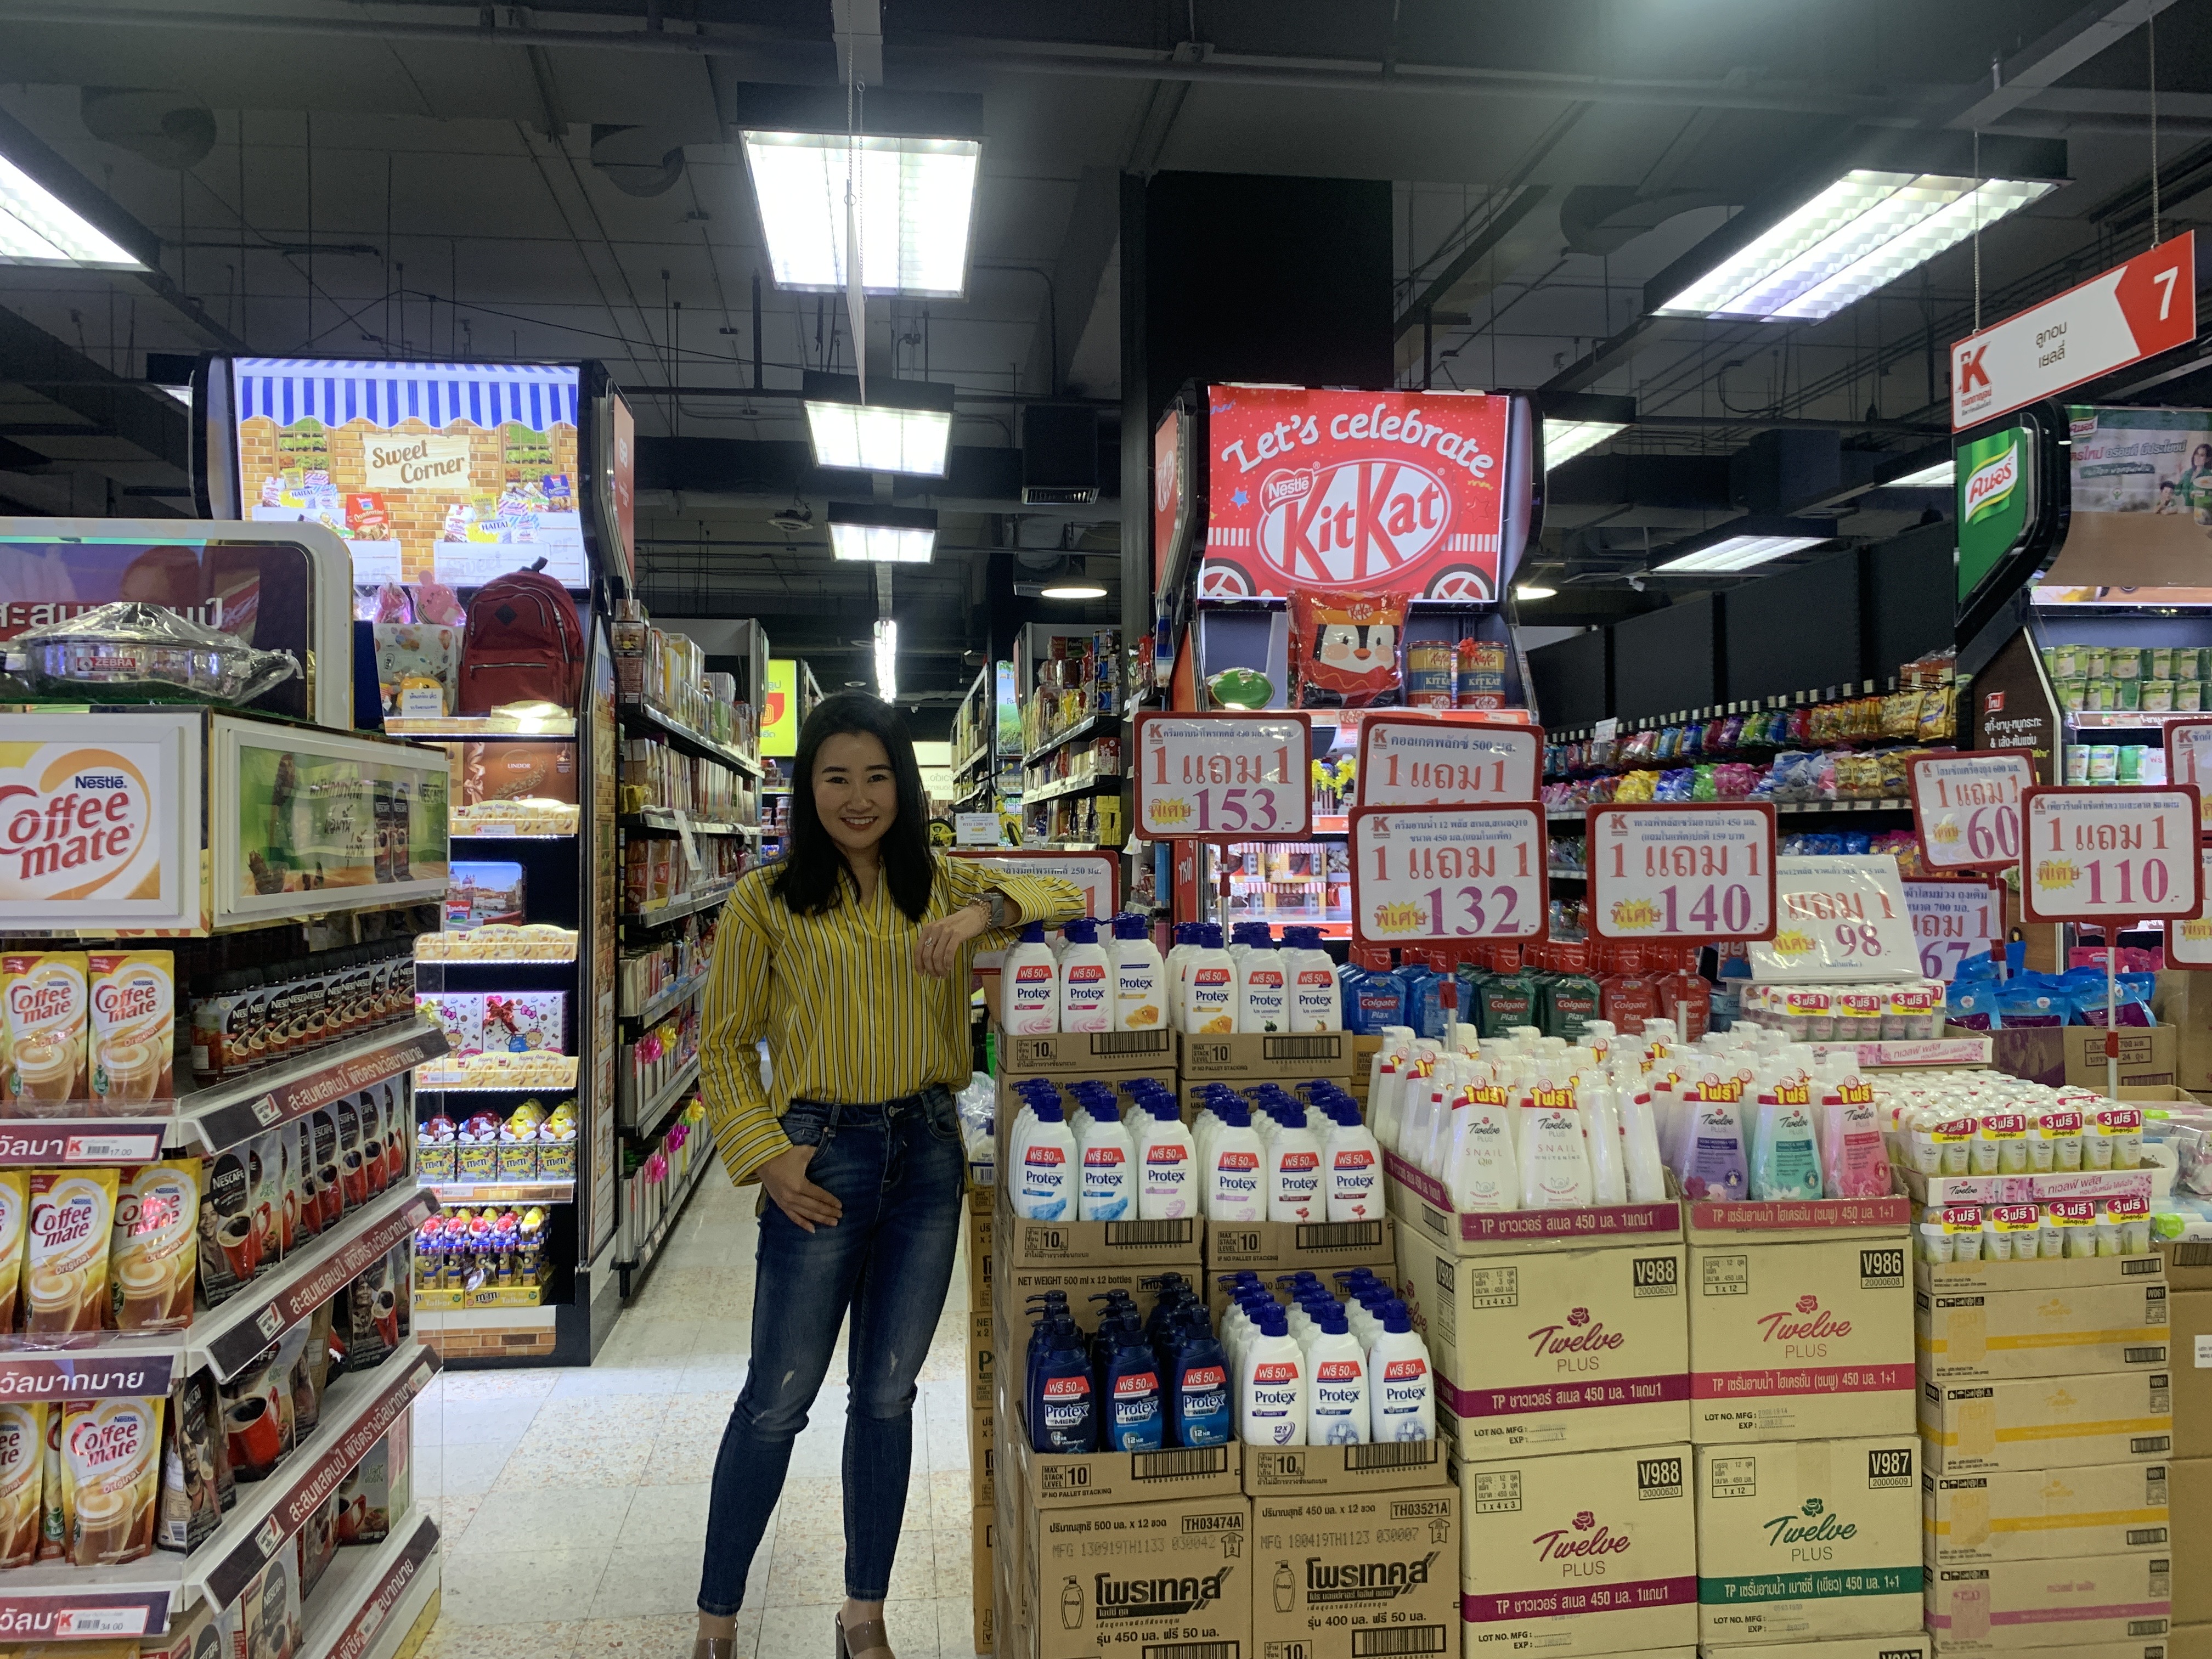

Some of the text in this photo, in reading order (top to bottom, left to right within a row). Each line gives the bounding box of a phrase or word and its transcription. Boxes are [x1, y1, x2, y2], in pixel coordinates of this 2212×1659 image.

[2154, 267, 2178, 321] 7
[2036, 321, 2067, 348] ลูกอม
[2039, 340, 2065, 368] เยลลี่
[1330, 404, 1494, 478] celebrate
[372, 438, 428, 469] Sweet
[400, 454, 466, 484] Corner
[1268, 475, 1310, 500] Nestlé
[481, 521, 509, 531] HAITAI
[1283, 464, 1440, 581] KitKat
[1348, 604, 1372, 620] KitKat
[95, 658, 133, 667] ZEBRA
[1472, 740, 1492, 751] 500
[1152, 746, 1293, 784] 1 แถม 1
[1384, 754, 1506, 793] 1 แถม 1
[75, 775, 125, 789] Nestlé
[1956, 782, 2003, 806] แถม
[1149, 799, 1191, 817] พิเศษ
[1968, 805, 2019, 860] 60
[19, 825, 131, 879] mate
[1610, 842, 1761, 877] 1 แถม 1
[1373, 842, 1532, 881] 1 แถม 1
[2036, 861, 2080, 880] พิเศษ
[1374, 905, 1427, 926] พิเศษ
[1611, 901, 1662, 922] พิเศษ
[1934, 904, 1970, 913] 700 มล.
[1021, 968, 1043, 978] ฟรี 50
[1074, 968, 1096, 978] ฟรี 50
[1120, 978, 1153, 989] Protex
[11, 985, 71, 1014] Coffee
[95, 985, 156, 1012] Coffee
[1018, 988, 1051, 1000] Protex
[1070, 988, 1105, 1000] Protex
[1196, 990, 1229, 1003] Protex
[1250, 995, 1283, 1007] Protex
[1299, 995, 1332, 1006] Protex
[1362, 998, 1397, 1008] Colgate
[1491, 1000, 1526, 1009] Colgate
[22, 1001, 71, 1024] mate
[109, 1000, 156, 1023] mate
[1371, 1011, 1389, 1019] Plax
[1500, 1012, 1518, 1020] Plax
[125, 1026, 157, 1047] Original
[1034, 1042, 1048, 1057] 10
[1212, 1046, 1228, 1060] 10
[1701, 1114, 1734, 1125] Twelve
[1780, 1116, 1808, 1128] Twelve
[1844, 1109, 1874, 1121] Twelve
[1468, 1123, 1500, 1134] Twelve
[1538, 1118, 1572, 1129] Twelve
[1466, 1148, 1502, 1156] SNAIL
[1026, 1171, 1063, 1186] Protex
[1086, 1172, 1123, 1186] Protex
[1481, 1219, 1494, 1233] TP
[1547, 1218, 1571, 1231] สเนล
[1576, 1216, 1595, 1229] 450
[55, 1251, 91, 1274] Original
[1864, 1252, 1901, 1274] V986
[1635, 1260, 1674, 1283] V988
[1018, 1277, 1031, 1285] NET
[1034, 1277, 1062, 1285] WEIGHT
[1064, 1277, 1077, 1285] 500
[1108, 1276, 1131, 1284] bottles
[1865, 1278, 1900, 1286] 20000608
[1638, 1286, 1673, 1295] 20000620
[1757, 1310, 1852, 1342] Twelve
[1528, 1323, 1624, 1357] Twelve
[1786, 1344, 1826, 1358] PLUS
[1558, 1356, 1599, 1372] PLUS
[1713, 1378, 1723, 1391] TP
[1814, 1373, 1838, 1391] (ชมพู)
[1881, 1370, 1895, 1384] 1+1
[1871, 1452, 1909, 1475] V987
[1393, 1502, 1448, 1516] TH03521A
[1050, 1521, 1091, 1534] ปริมาณสุทธิ
[1094, 1521, 1111, 1530] 500
[1184, 1516, 1240, 1531] TH03474A
[1763, 1514, 1857, 1546] Twelve
[1052, 1543, 1074, 1558] MFG
[1533, 1526, 1630, 1562] Twelve
[1792, 1547, 1832, 1562] PLUS
[1816, 1577, 1842, 1594] (เขียว)
[1325, 1616, 1347, 1626] 400
[1097, 1627, 1198, 1647] รุ่น 450 มล. ฟรี 50
